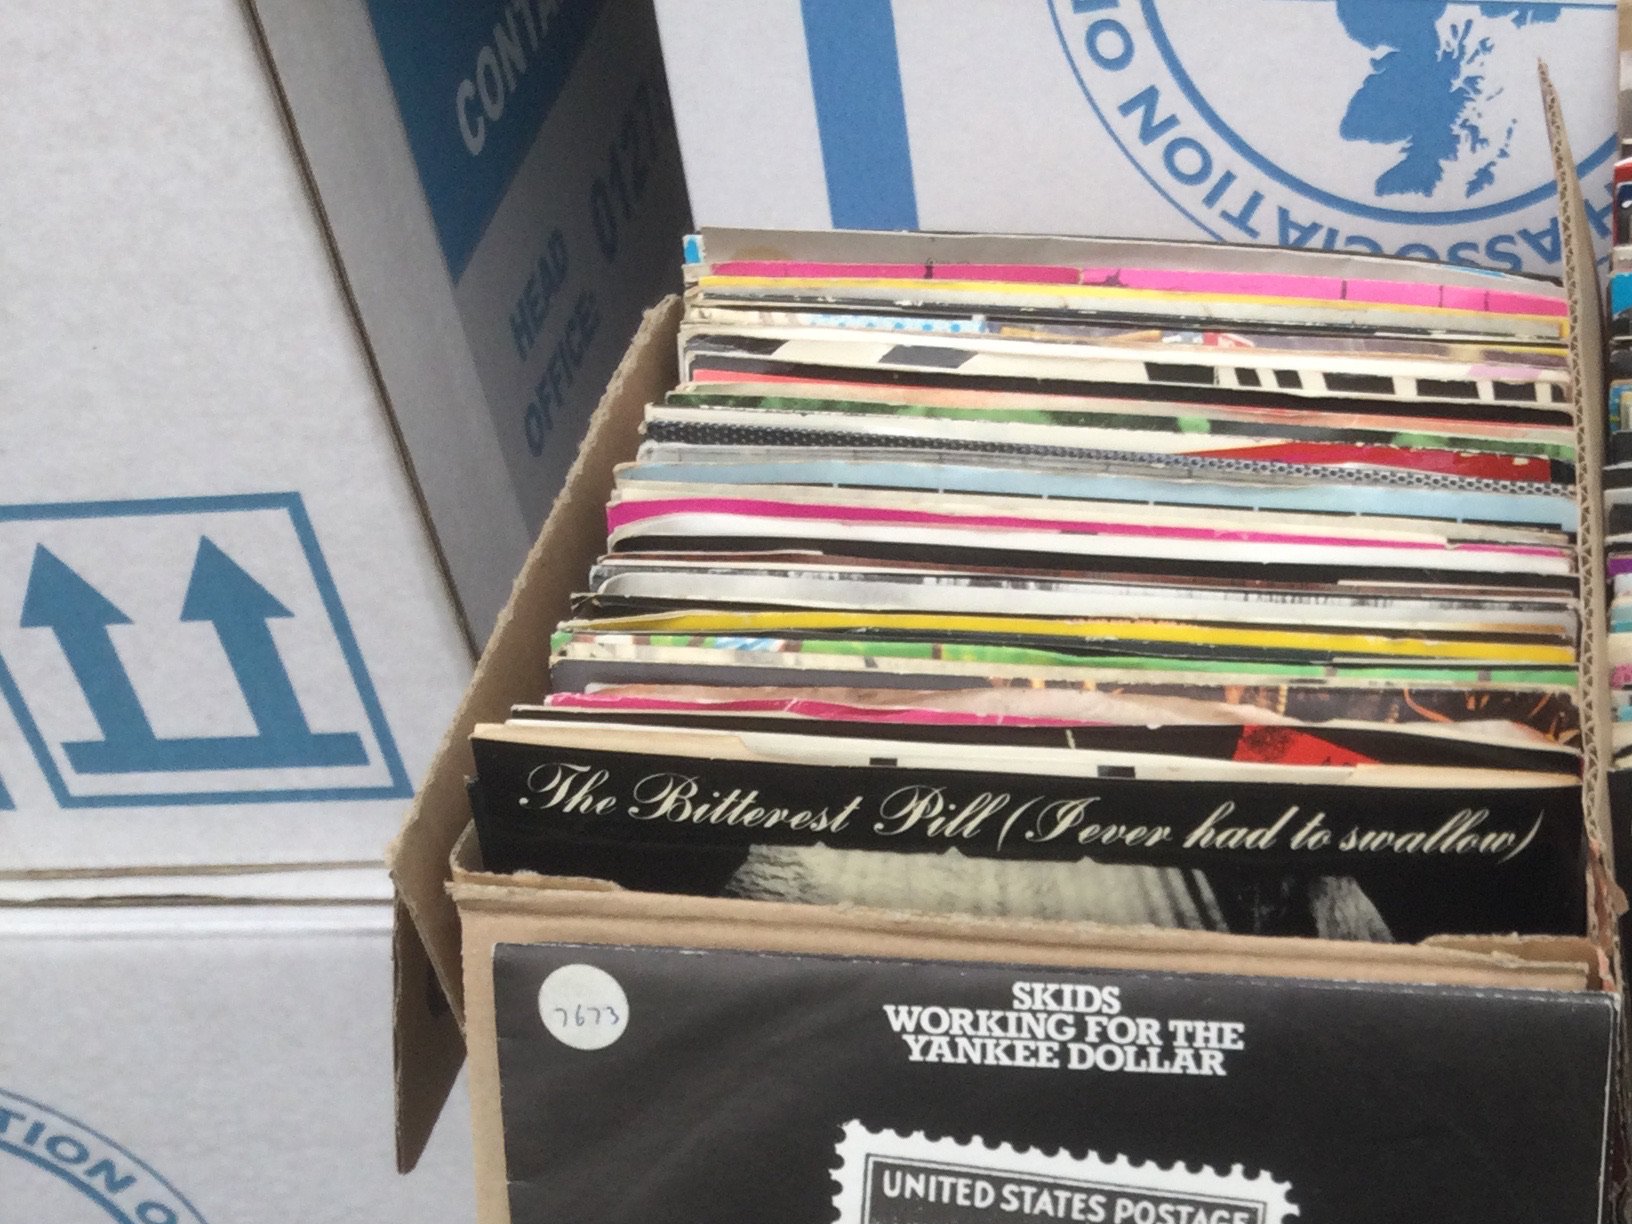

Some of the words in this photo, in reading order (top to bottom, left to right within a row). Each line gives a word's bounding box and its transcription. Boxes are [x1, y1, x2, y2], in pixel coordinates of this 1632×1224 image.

[518, 762, 618, 817] The
[627, 772, 862, 834] Bitterest
[873, 784, 1012, 840] Pill
[1083, 818, 1173, 847] ever
[1182, 801, 1300, 851] had
[1288, 816, 1333, 849] to
[1337, 808, 1545, 865] swallow)
[553, 1004, 620, 1028] 7673
[1011, 981, 1121, 1015] SKIDS
[883, 1005, 1076, 1044] WORKING
[1083, 1017, 1163, 1047] FOR
[1168, 1021, 1245, 1051] THE
[902, 1034, 1061, 1070] YANKEE
[1067, 1044, 1226, 1077] DOLLAR
[882, 1170, 996, 1210] UNITED
[1001, 1181, 1107, 1224] STATES
